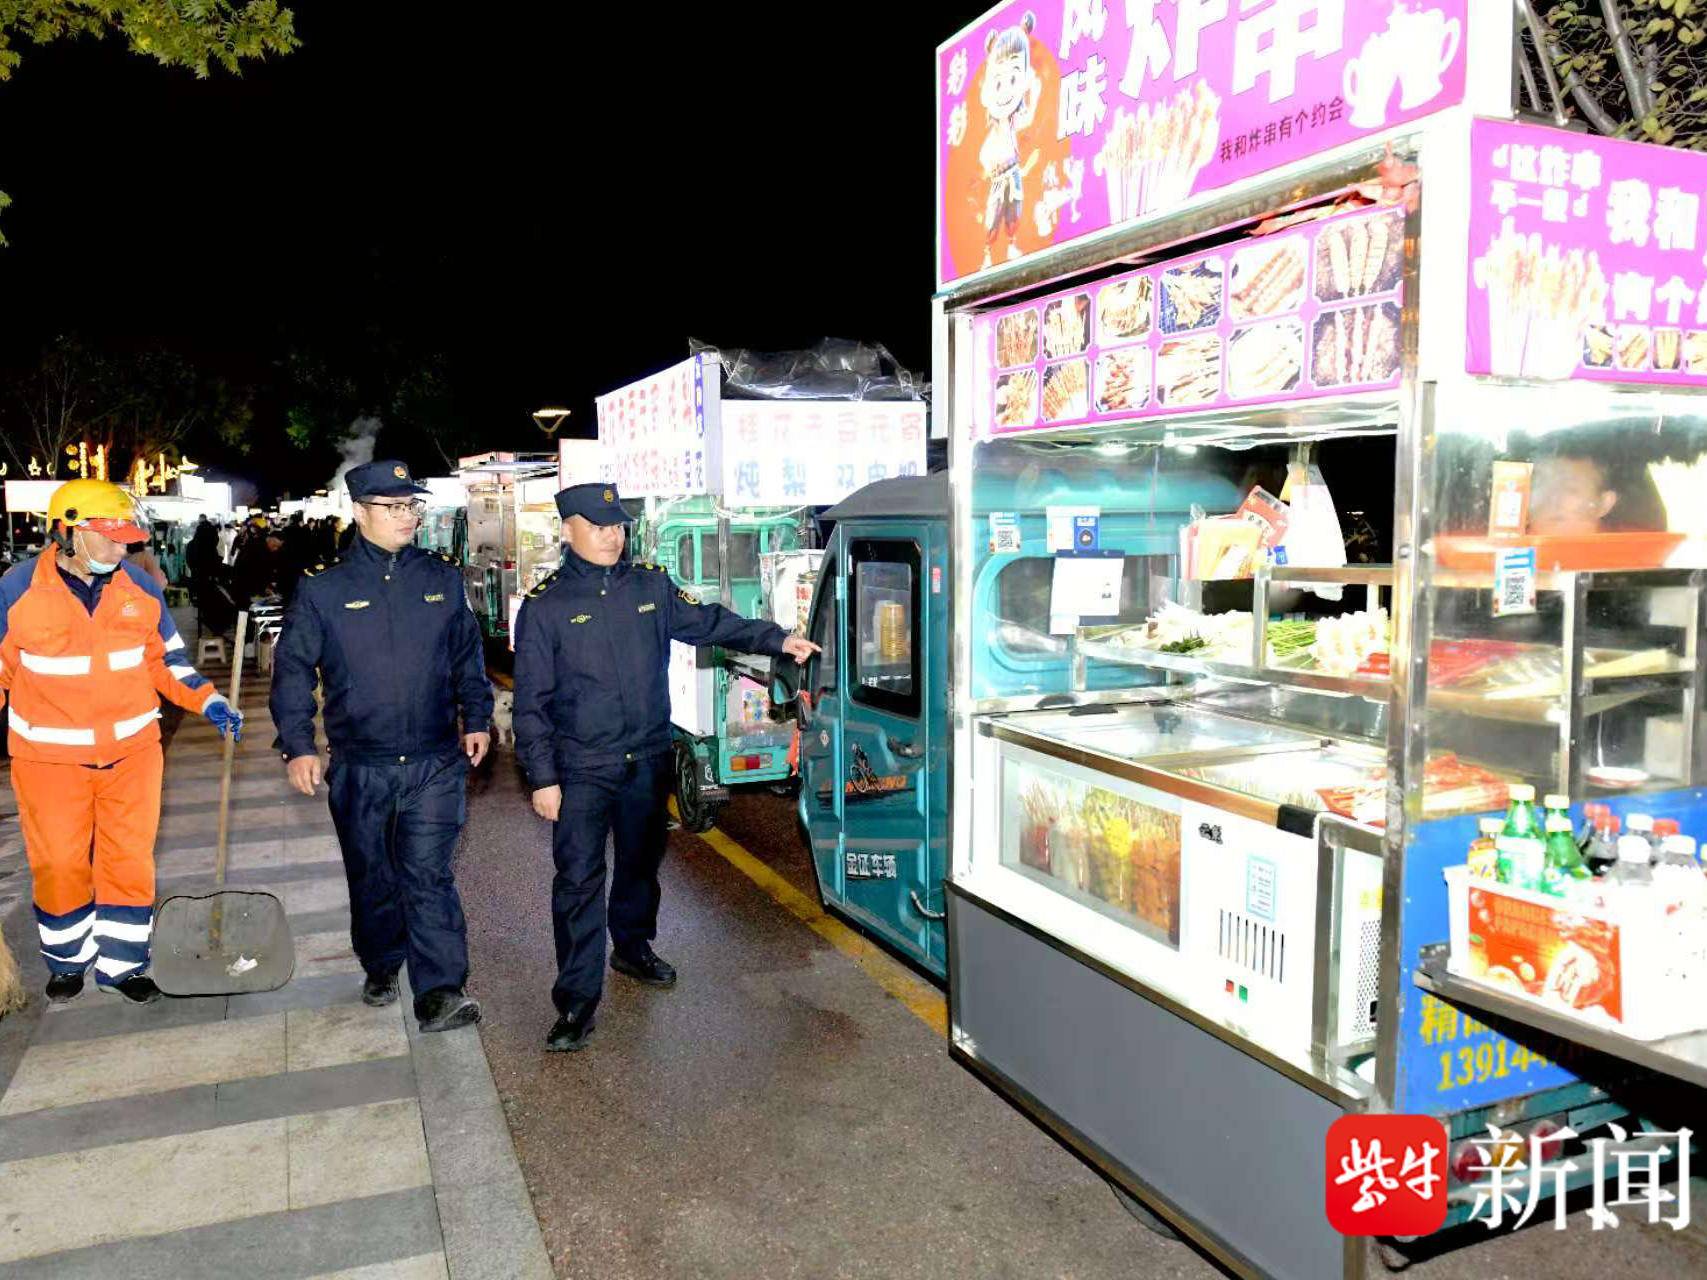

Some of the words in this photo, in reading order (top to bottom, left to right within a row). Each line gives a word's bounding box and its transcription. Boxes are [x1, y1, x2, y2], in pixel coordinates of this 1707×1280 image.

[1118, 0, 1344, 104] 炸串
[1220, 96, 1345, 164] 我和炸串有个约会
[1612, 271, 1707, 324] 有个
[1437, 1039, 1557, 1092] 13914
